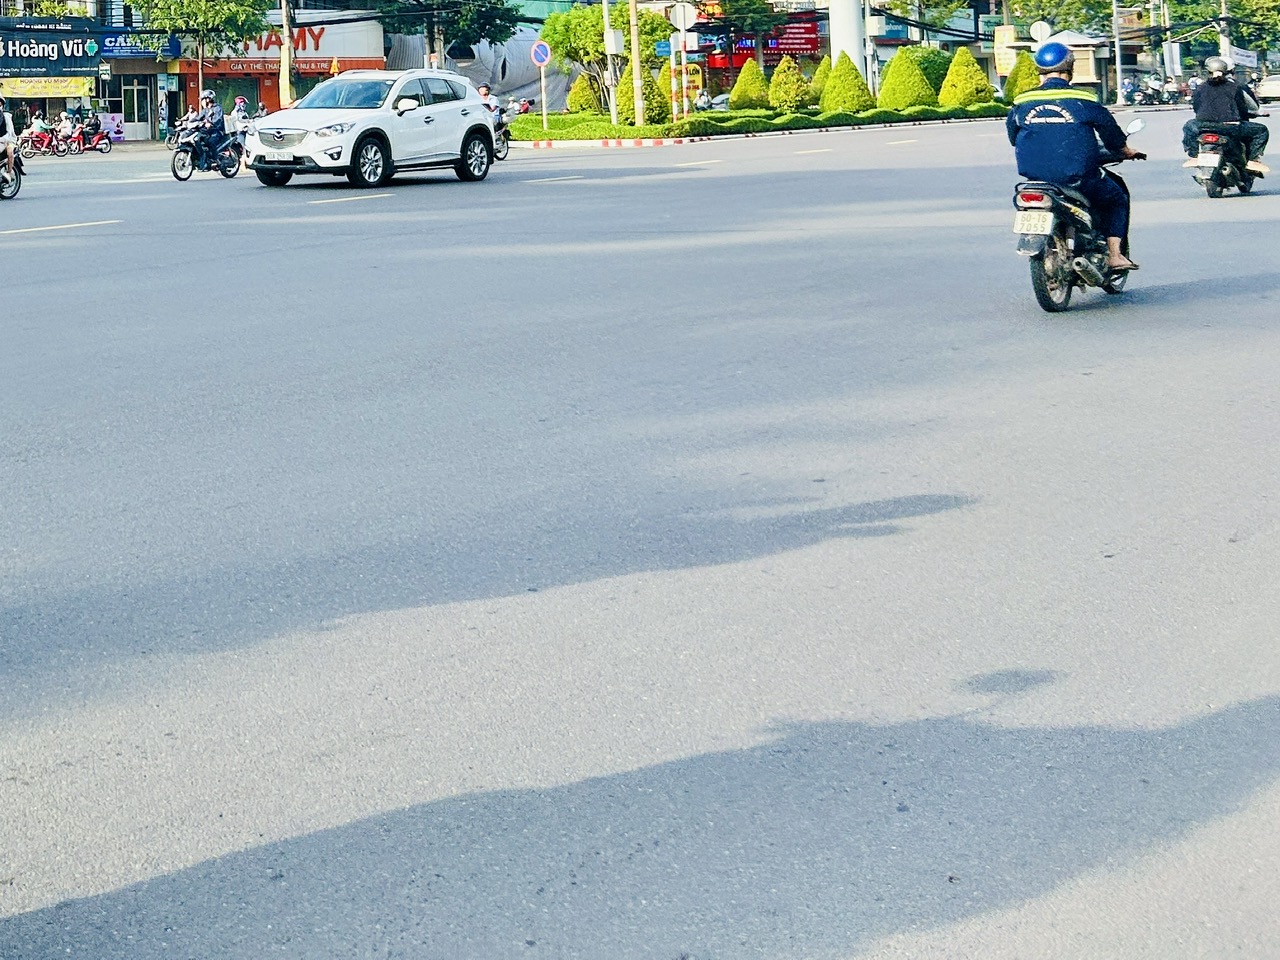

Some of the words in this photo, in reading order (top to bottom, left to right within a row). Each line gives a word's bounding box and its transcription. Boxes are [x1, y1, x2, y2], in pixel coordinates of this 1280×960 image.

[8, 38, 58, 60] Hoàng
[61, 38, 83, 57] Vũ
[1019, 223, 1046, 232] 7055
